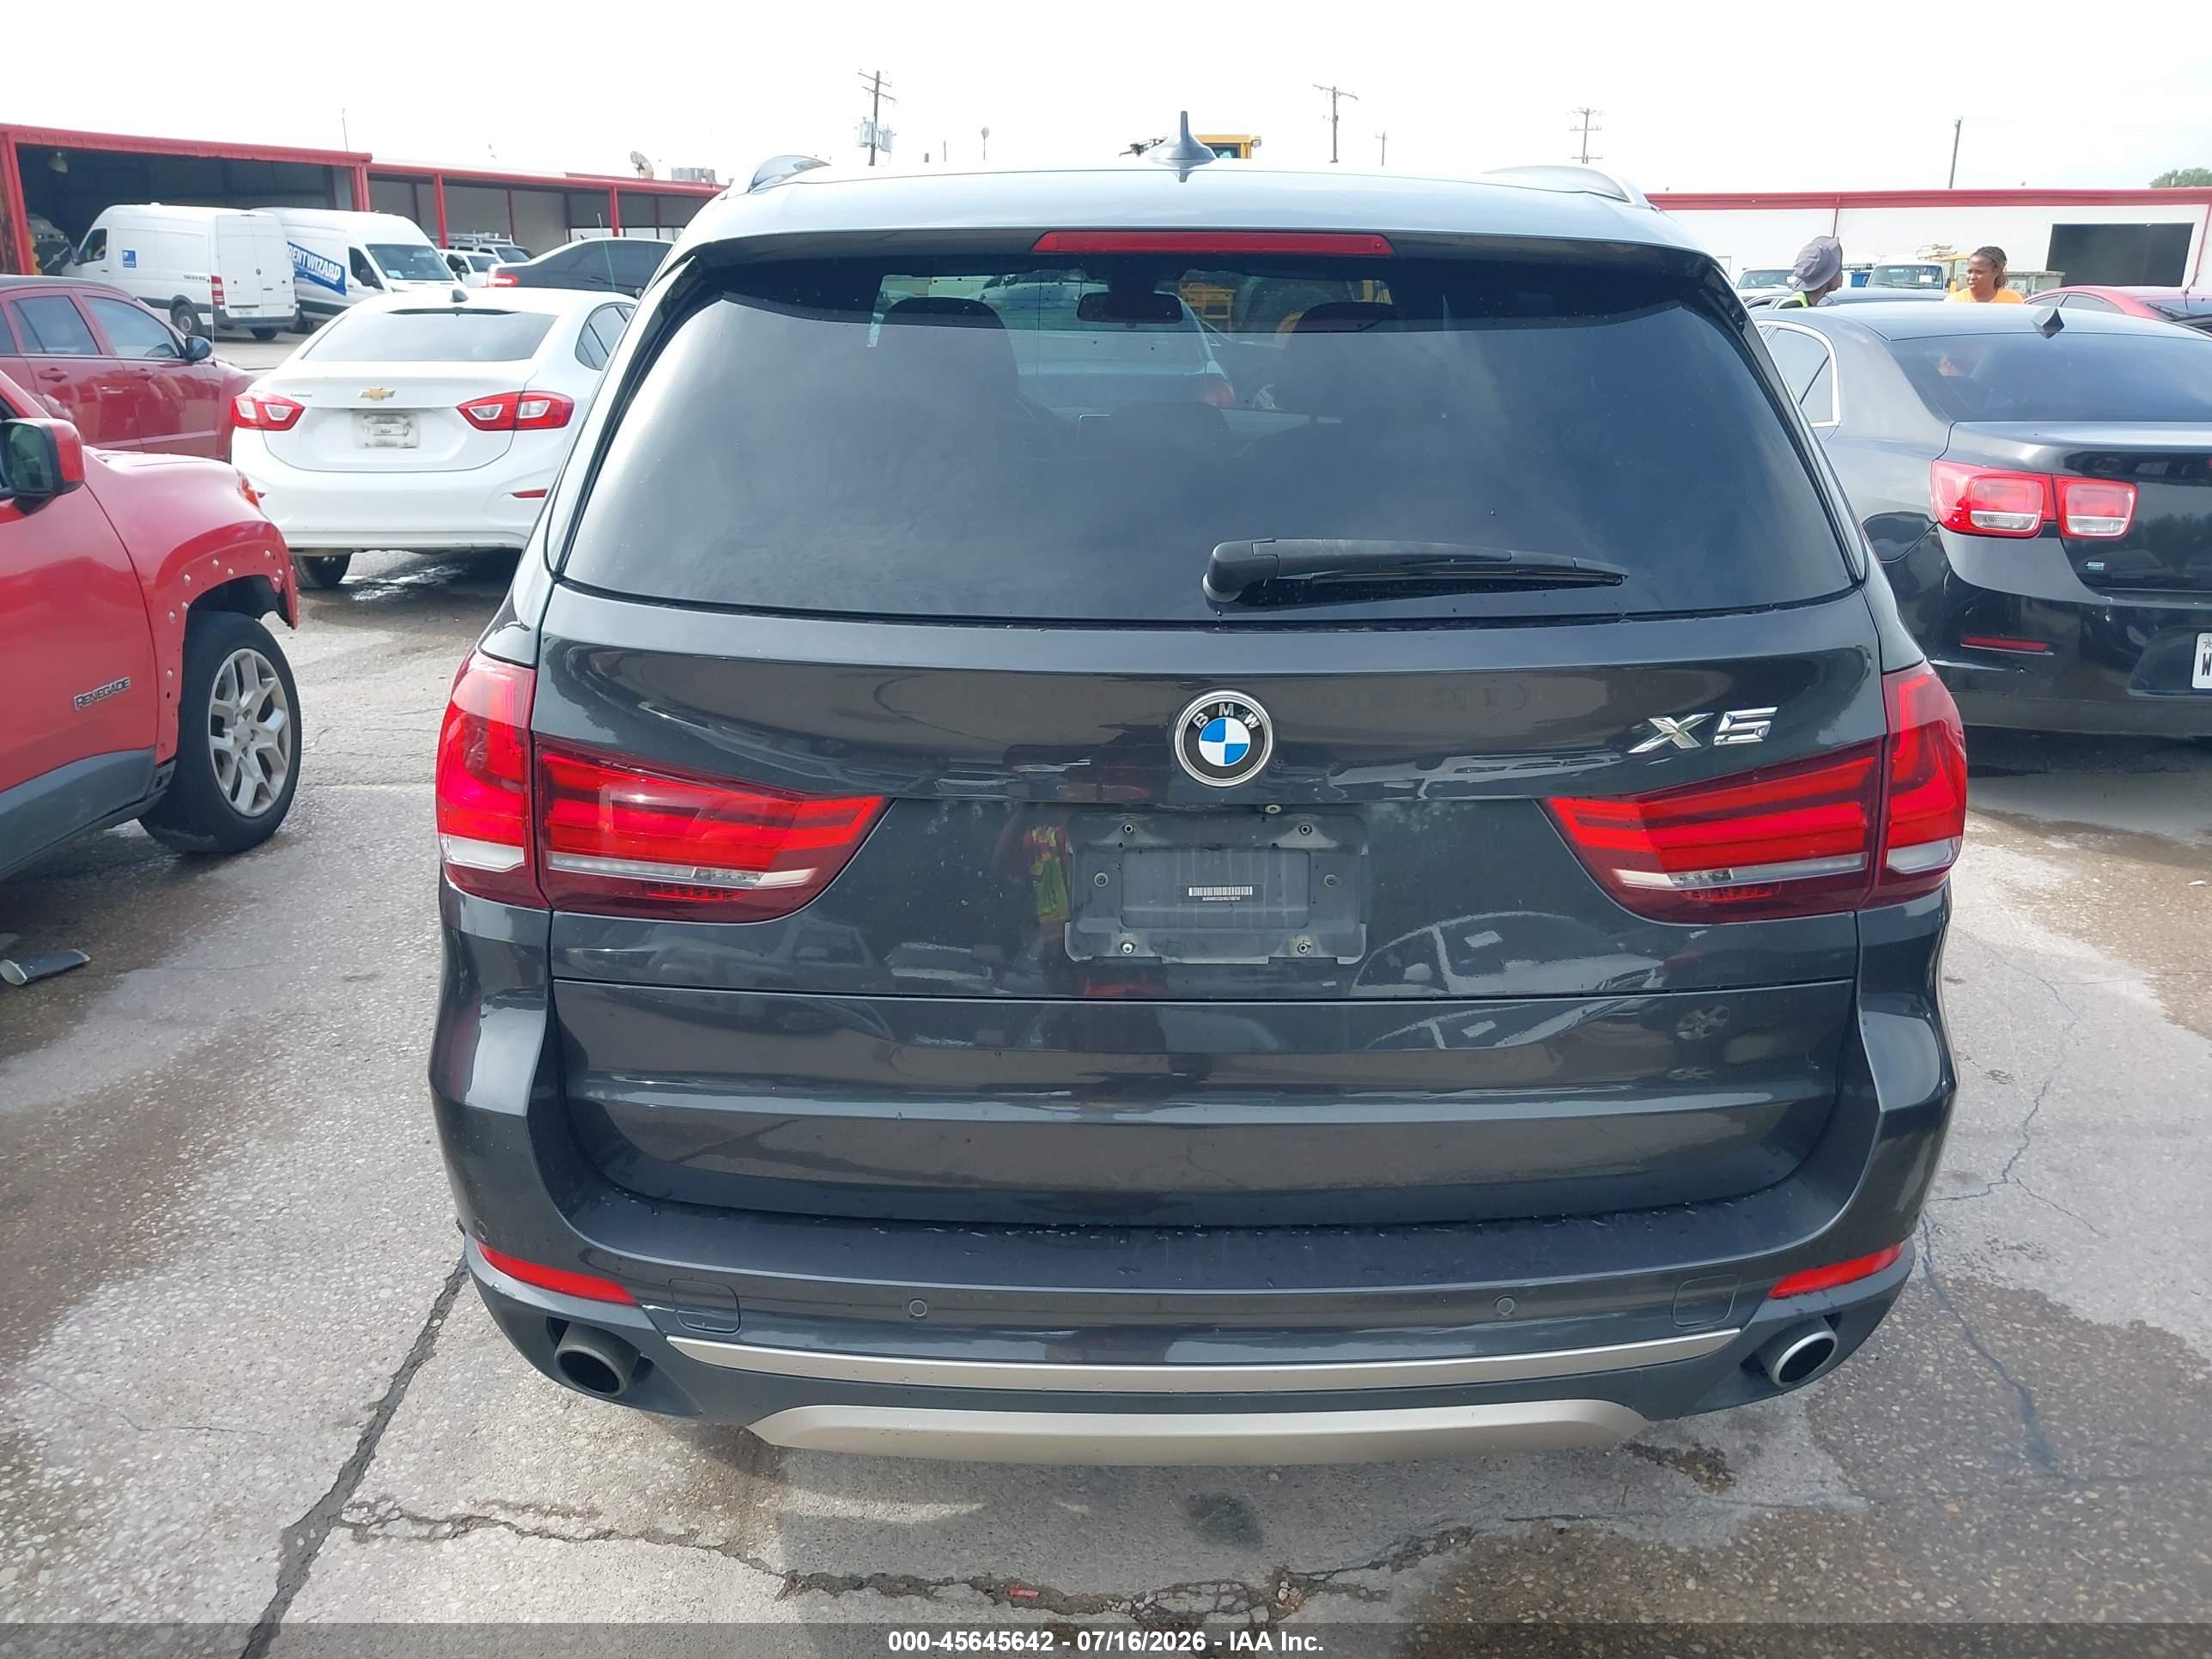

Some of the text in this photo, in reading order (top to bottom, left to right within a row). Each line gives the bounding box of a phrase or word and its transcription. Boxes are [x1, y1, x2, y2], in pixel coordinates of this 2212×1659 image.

[74, 676, 131, 710] RENEGADE
[1192, 702, 1261, 730] BMW
[1627, 707, 1778, 754] X5
